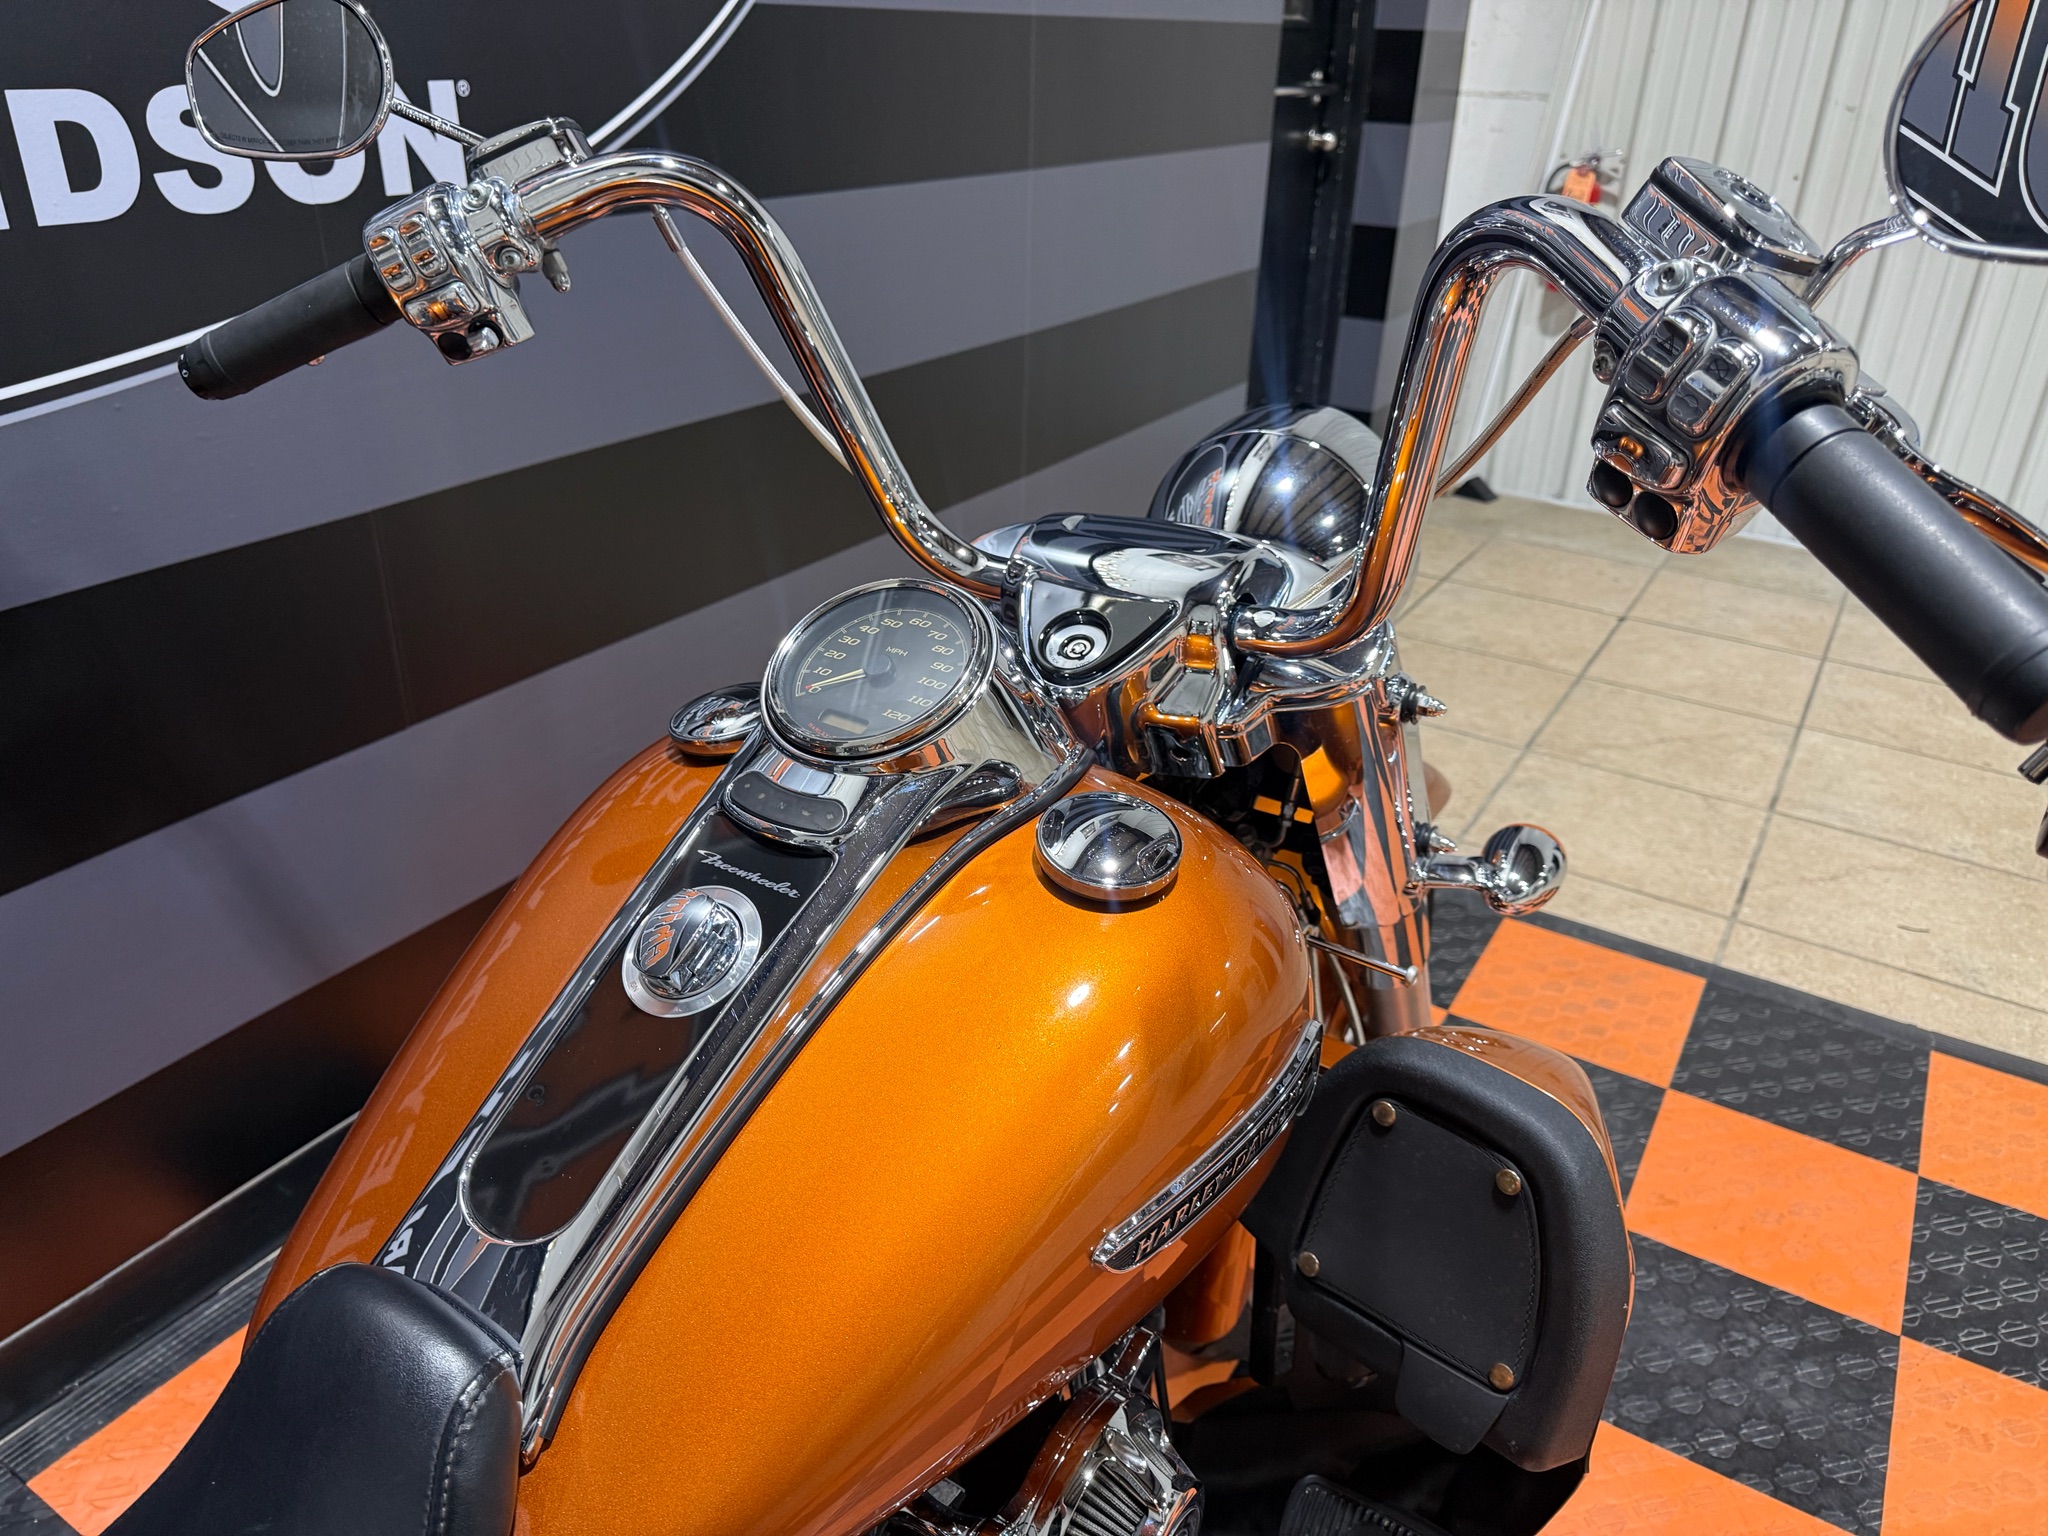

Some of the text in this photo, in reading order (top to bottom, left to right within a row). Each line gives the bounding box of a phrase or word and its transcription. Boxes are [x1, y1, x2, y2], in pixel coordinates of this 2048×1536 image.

[0, 79, 468, 231] DSN
[880, 618, 903, 628] 50
[909, 618, 932, 628] 60
[859, 625, 880, 635] 40
[927, 630, 948, 640] 70
[838, 635, 861, 646] 30
[823, 649, 847, 660] 20
[885, 646, 908, 657] MPH
[931, 645, 955, 656] 80
[812, 666, 833, 676] 10
[930, 662, 954, 673] 90
[916, 677, 947, 690] 100
[907, 695, 934, 707] 110
[882, 709, 911, 722] 120
[697, 849, 801, 899] Freewheeler
